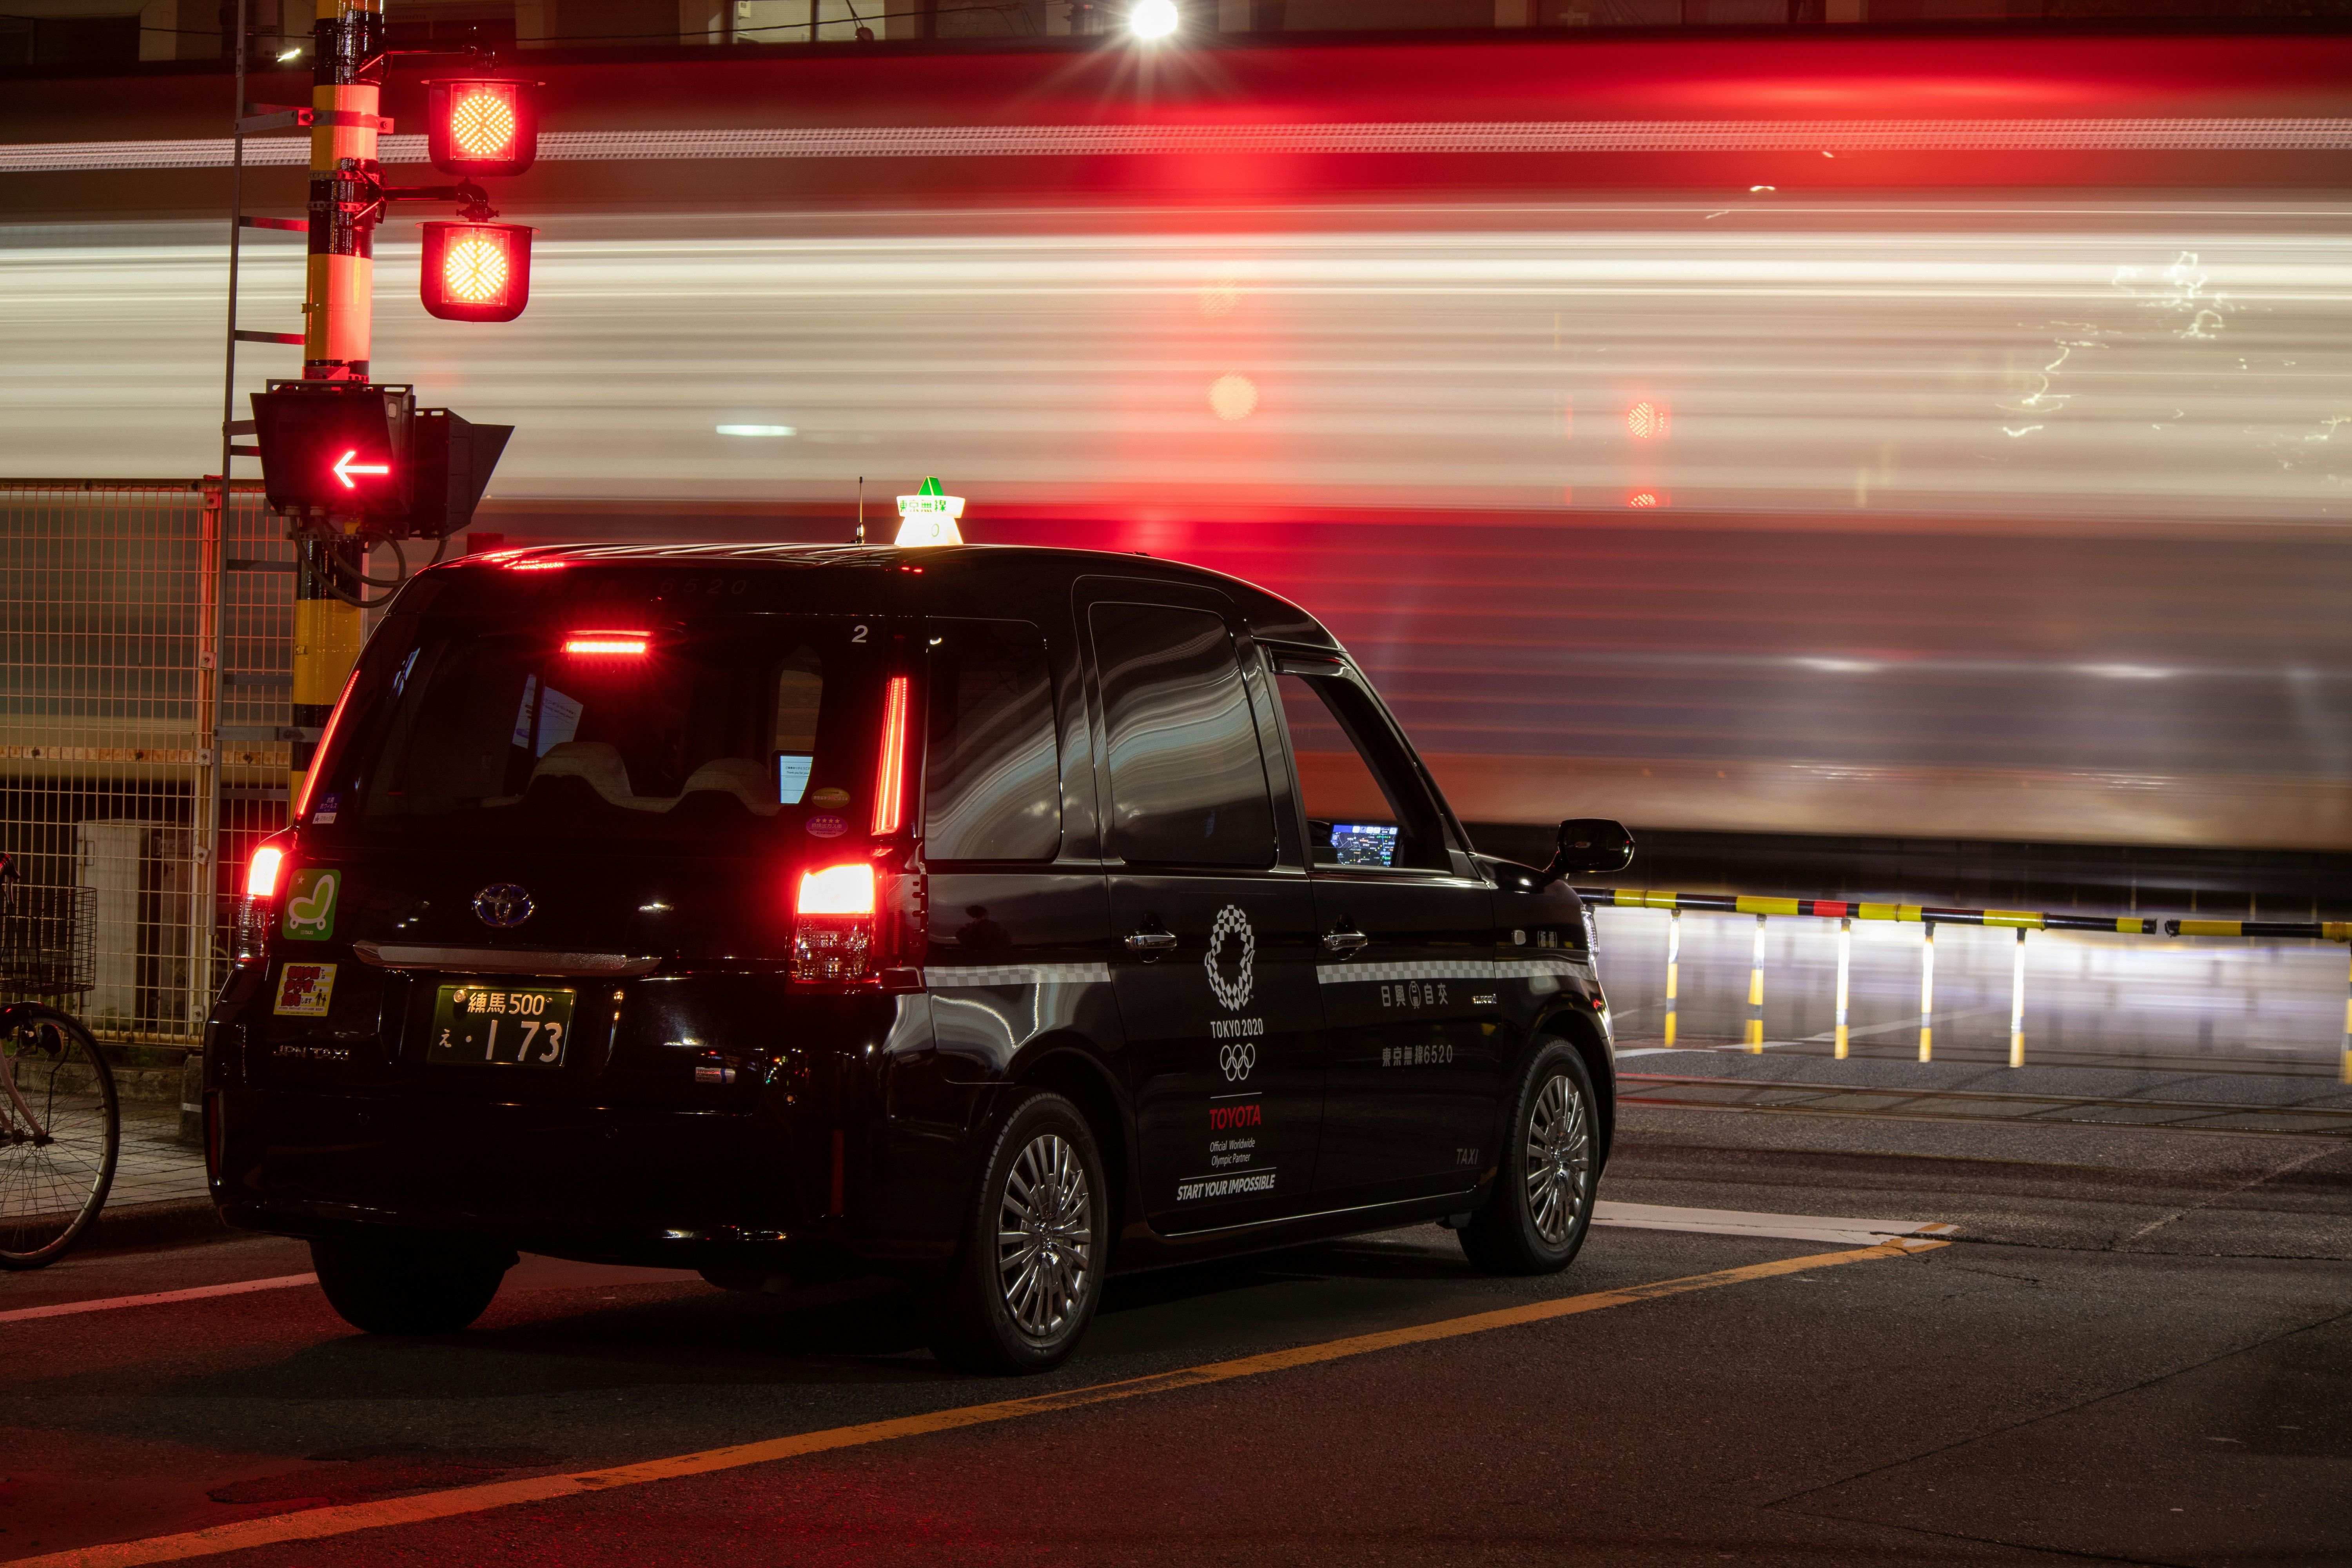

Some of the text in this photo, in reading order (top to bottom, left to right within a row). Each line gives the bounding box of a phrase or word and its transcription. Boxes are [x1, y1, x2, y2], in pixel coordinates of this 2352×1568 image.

[899, 499, 947, 512] 東京無線
[660, 578, 748, 595] 6520
[851, 625, 868, 643] 2
[467, 992, 545, 1015] 練馬 500
[1210, 1018, 1263, 1038] TOKYO 2020
[439, 1029, 452, 1048] え
[310, 1047, 350, 1061] TAXI
[1209, 1105, 1261, 1130] TOYOTA
[1210, 1138, 1255, 1152] Official Worldwide
[1212, 1154, 1251, 1168] Olympic Partner
[1456, 1148, 1479, 1165] TAXI
[1177, 1174, 1276, 1201] START YOUR IMPOSSIBLE
